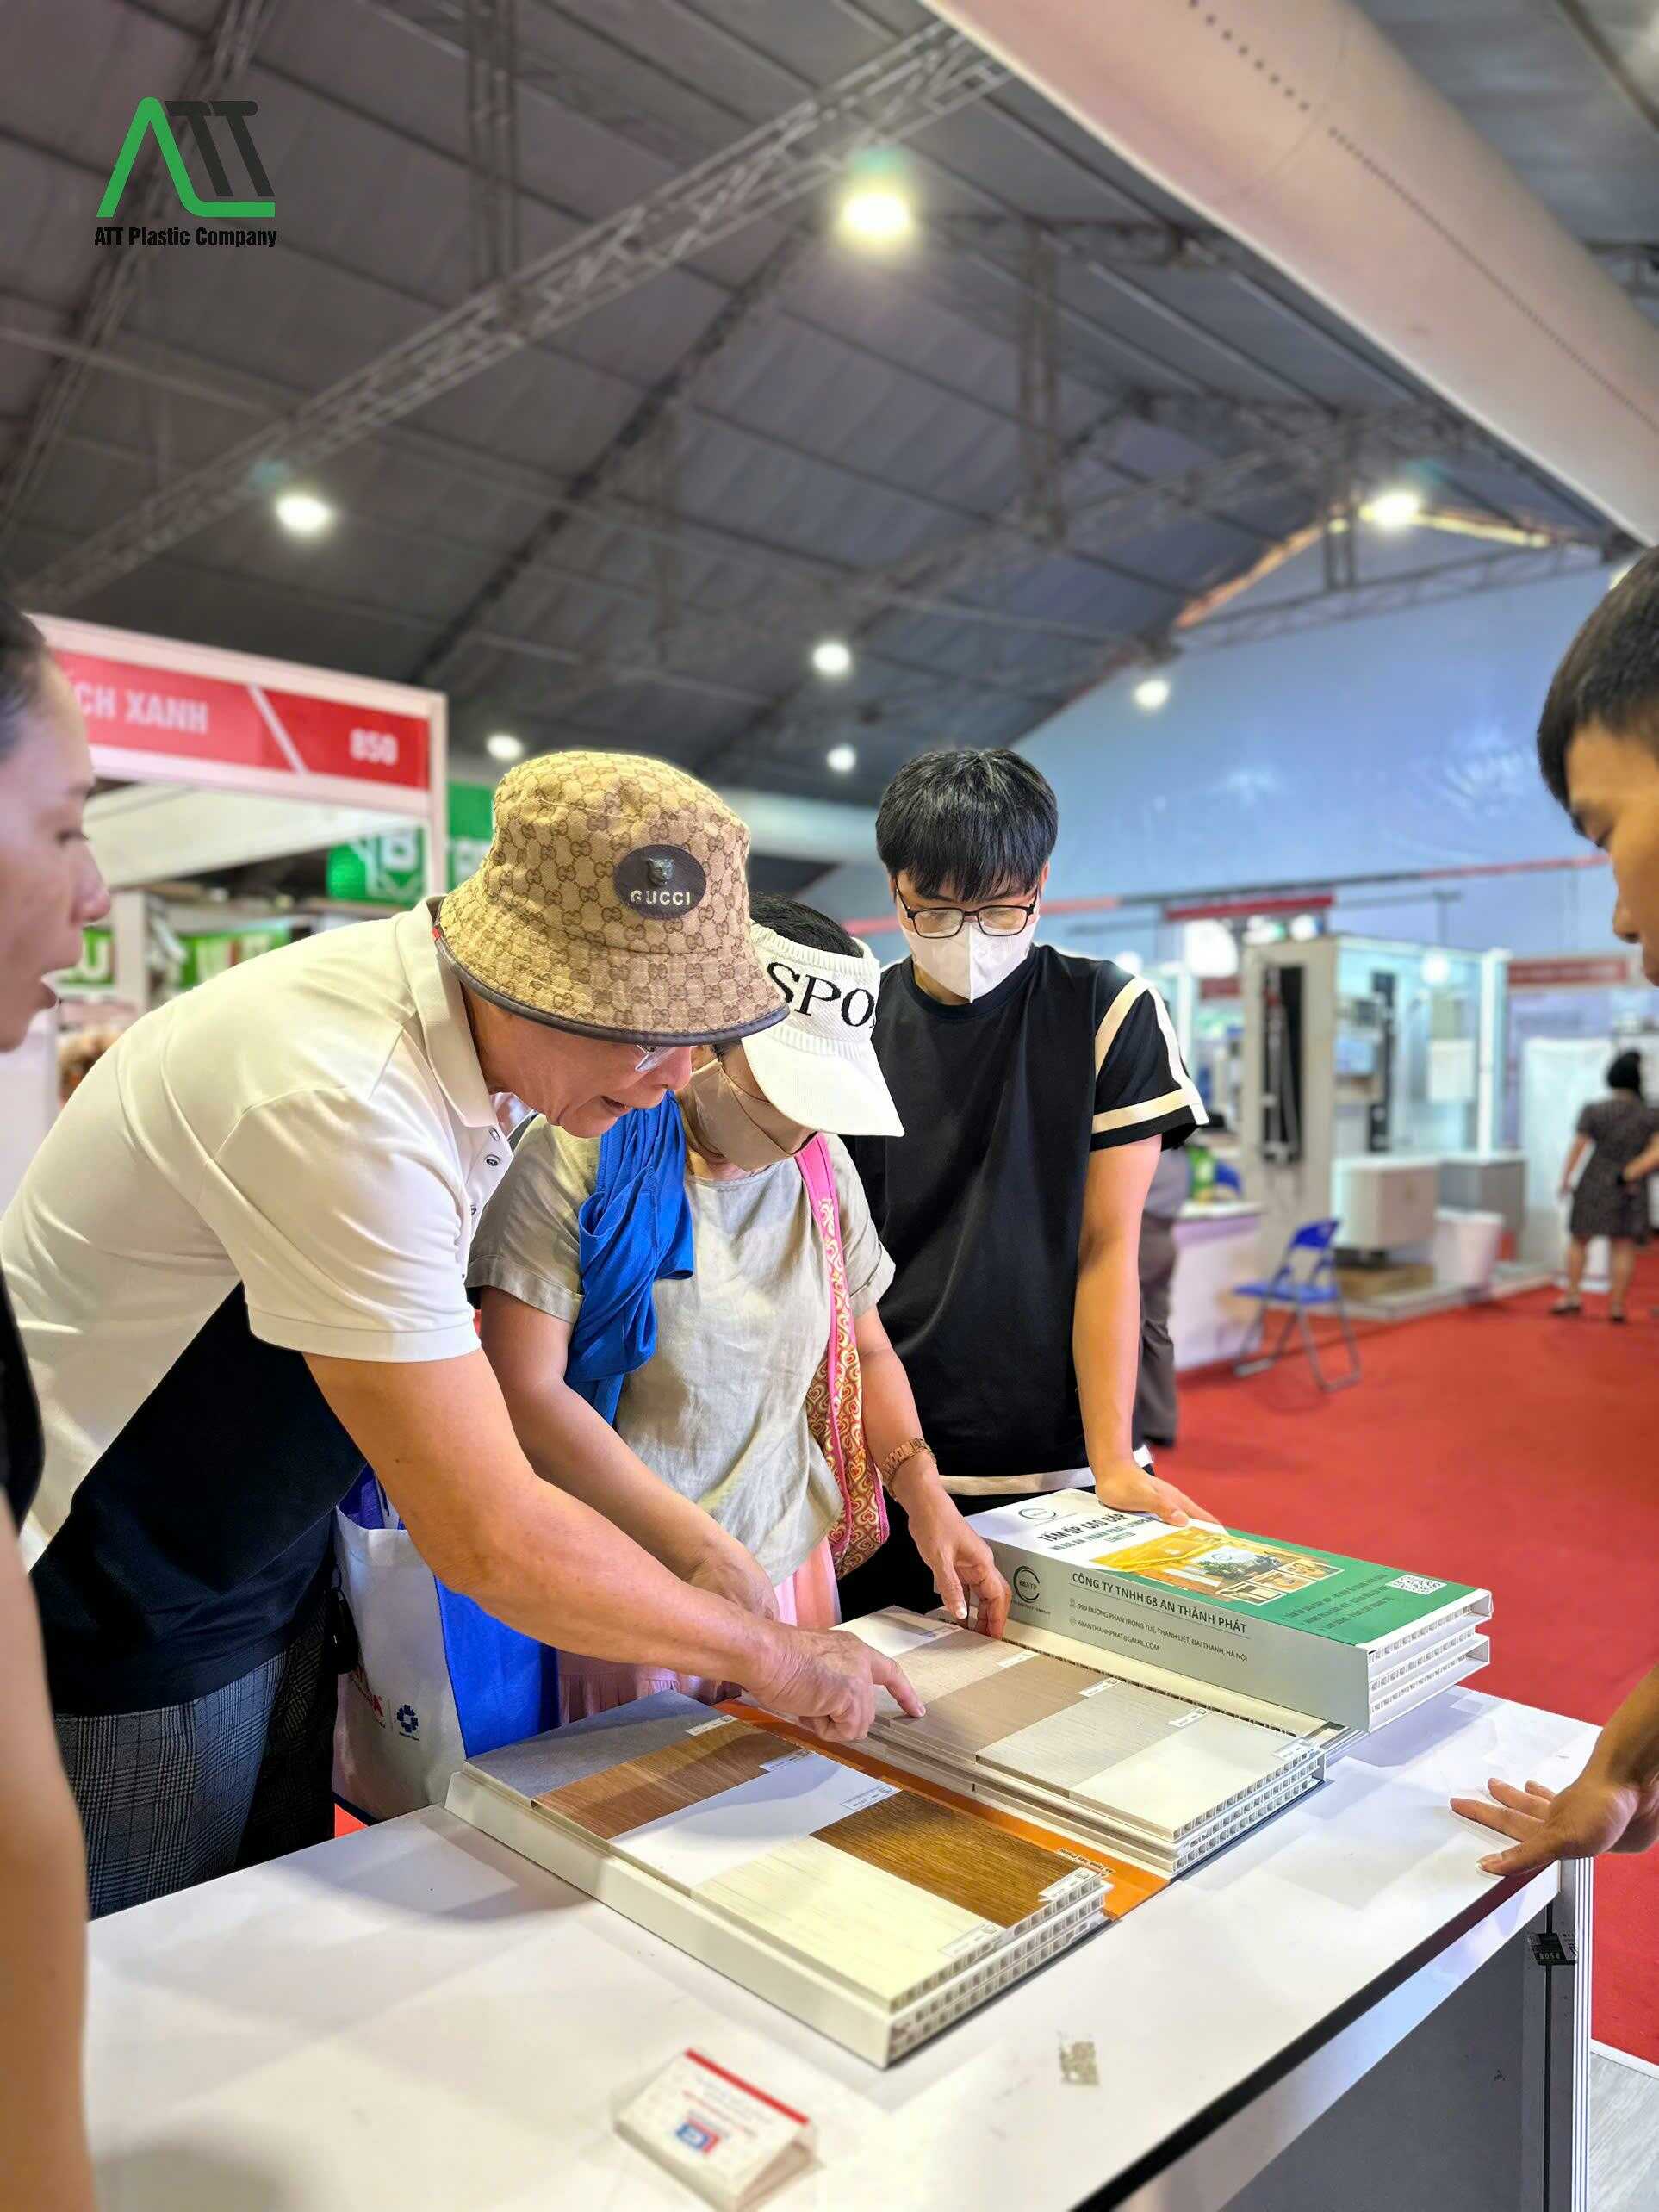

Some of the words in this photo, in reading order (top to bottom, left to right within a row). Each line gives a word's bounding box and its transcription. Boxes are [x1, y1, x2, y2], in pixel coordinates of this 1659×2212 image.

[69, 674, 117, 721] CH
[124, 688, 210, 736] XANH
[349, 729, 400, 765] 850
[630, 889, 690, 906] GUCCI
[766, 961, 876, 1028] SPO
[1079, 1519, 1109, 1529] CAO
[1072, 1572, 1100, 1589] CÔNG
[1102, 1581, 1114, 1593] TY
[1115, 1585, 1144, 1602] TNHH
[1146, 1594, 1158, 1606] 68
[1159, 1600, 1176, 1612] AN
[1177, 1604, 1215, 1625] THÀNH
[1218, 1617, 1247, 1634] PHÁT
